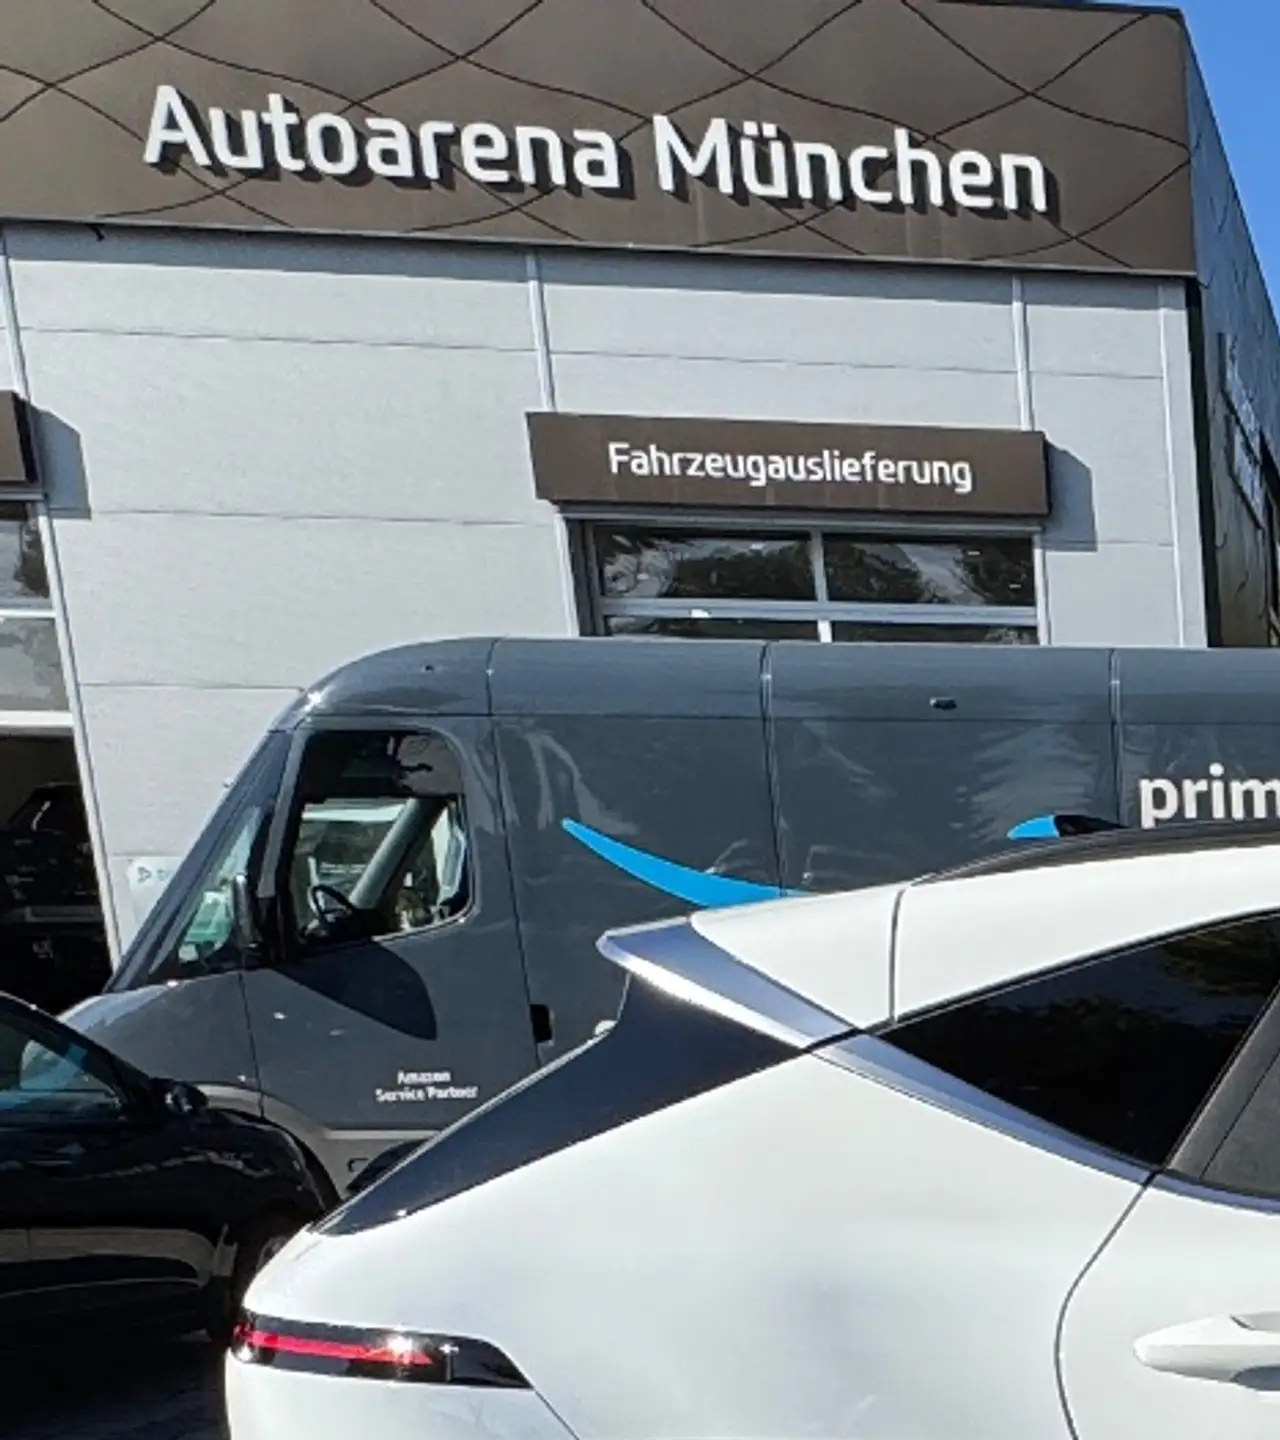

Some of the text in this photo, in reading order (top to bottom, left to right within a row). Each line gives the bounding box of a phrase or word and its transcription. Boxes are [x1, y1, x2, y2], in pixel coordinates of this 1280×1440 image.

[144, 84, 1048, 212] Autoarena München
[608, 442, 973, 493] Fahrzeugauslieferung
[397, 1070, 451, 1084] Amazon
[375, 1086, 479, 1102] Service Partner
